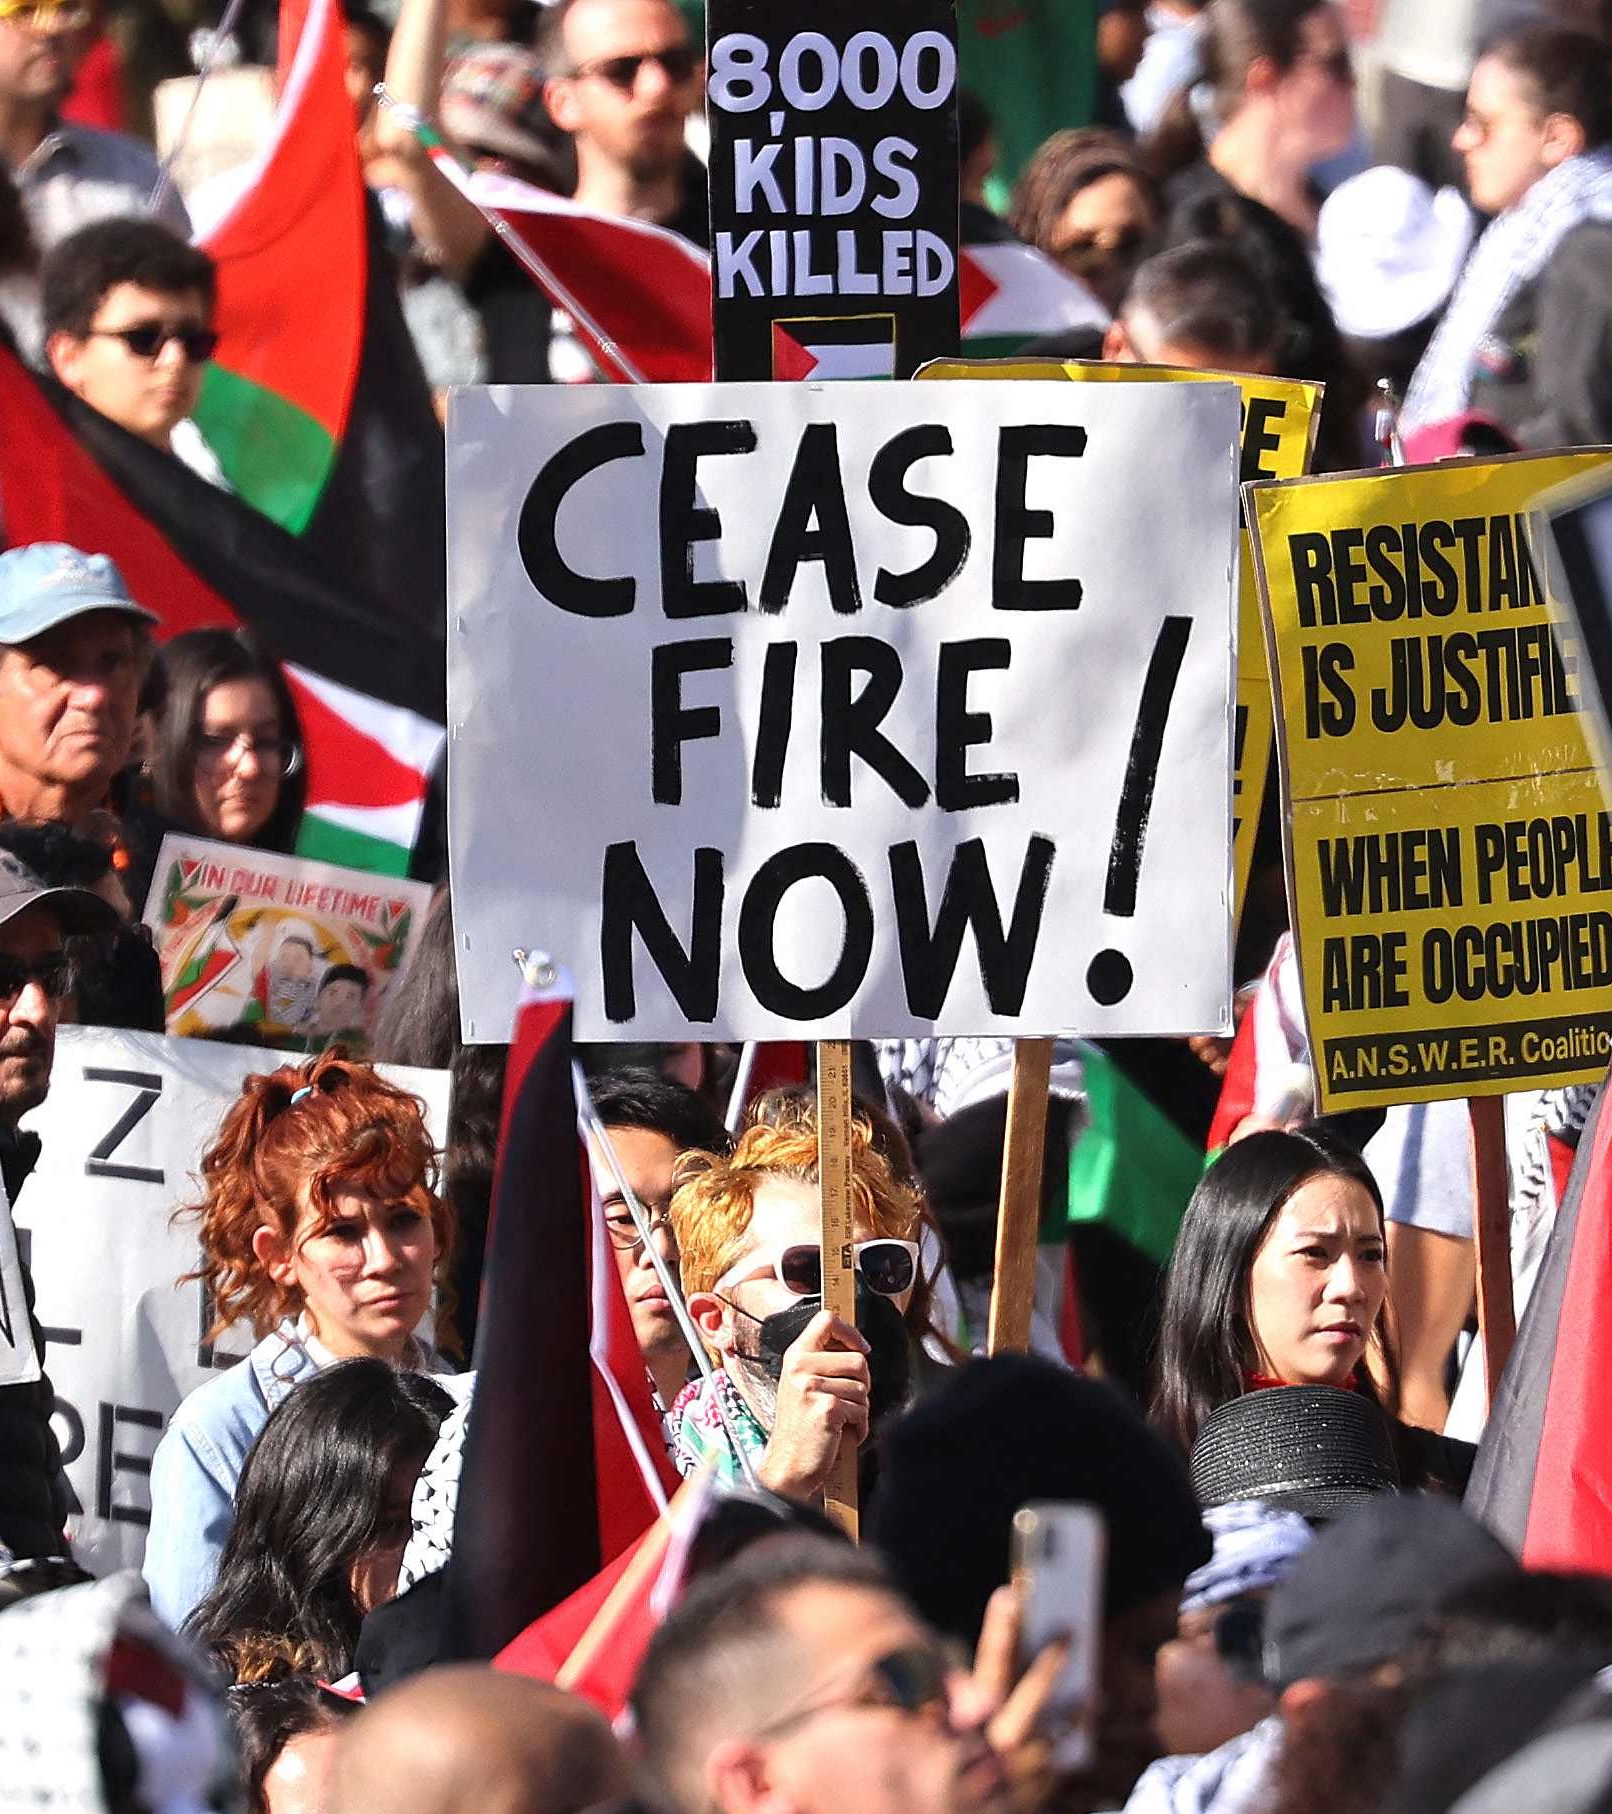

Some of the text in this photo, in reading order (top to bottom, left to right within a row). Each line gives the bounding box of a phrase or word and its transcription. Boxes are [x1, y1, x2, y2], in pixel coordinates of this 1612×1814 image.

[735, 136, 920, 219] KIDS
[717, 229, 955, 299] KILLED
[517, 420, 1087, 618] CEASE
[1288, 510, 1548, 628] RESISTAN
[1300, 622, 1581, 739] IS JUSTIFIE
[651, 637, 1020, 810] FIRE
[201, 863, 383, 920] IN OUR LIFETIME
[1317, 826, 1463, 918] WHEN
[1322, 930, 1410, 1013] ARE
[1331, 1027, 1611, 1081] A.N.S.W.E.R. Coalitio
[841, 1243, 852, 1269] ETA
